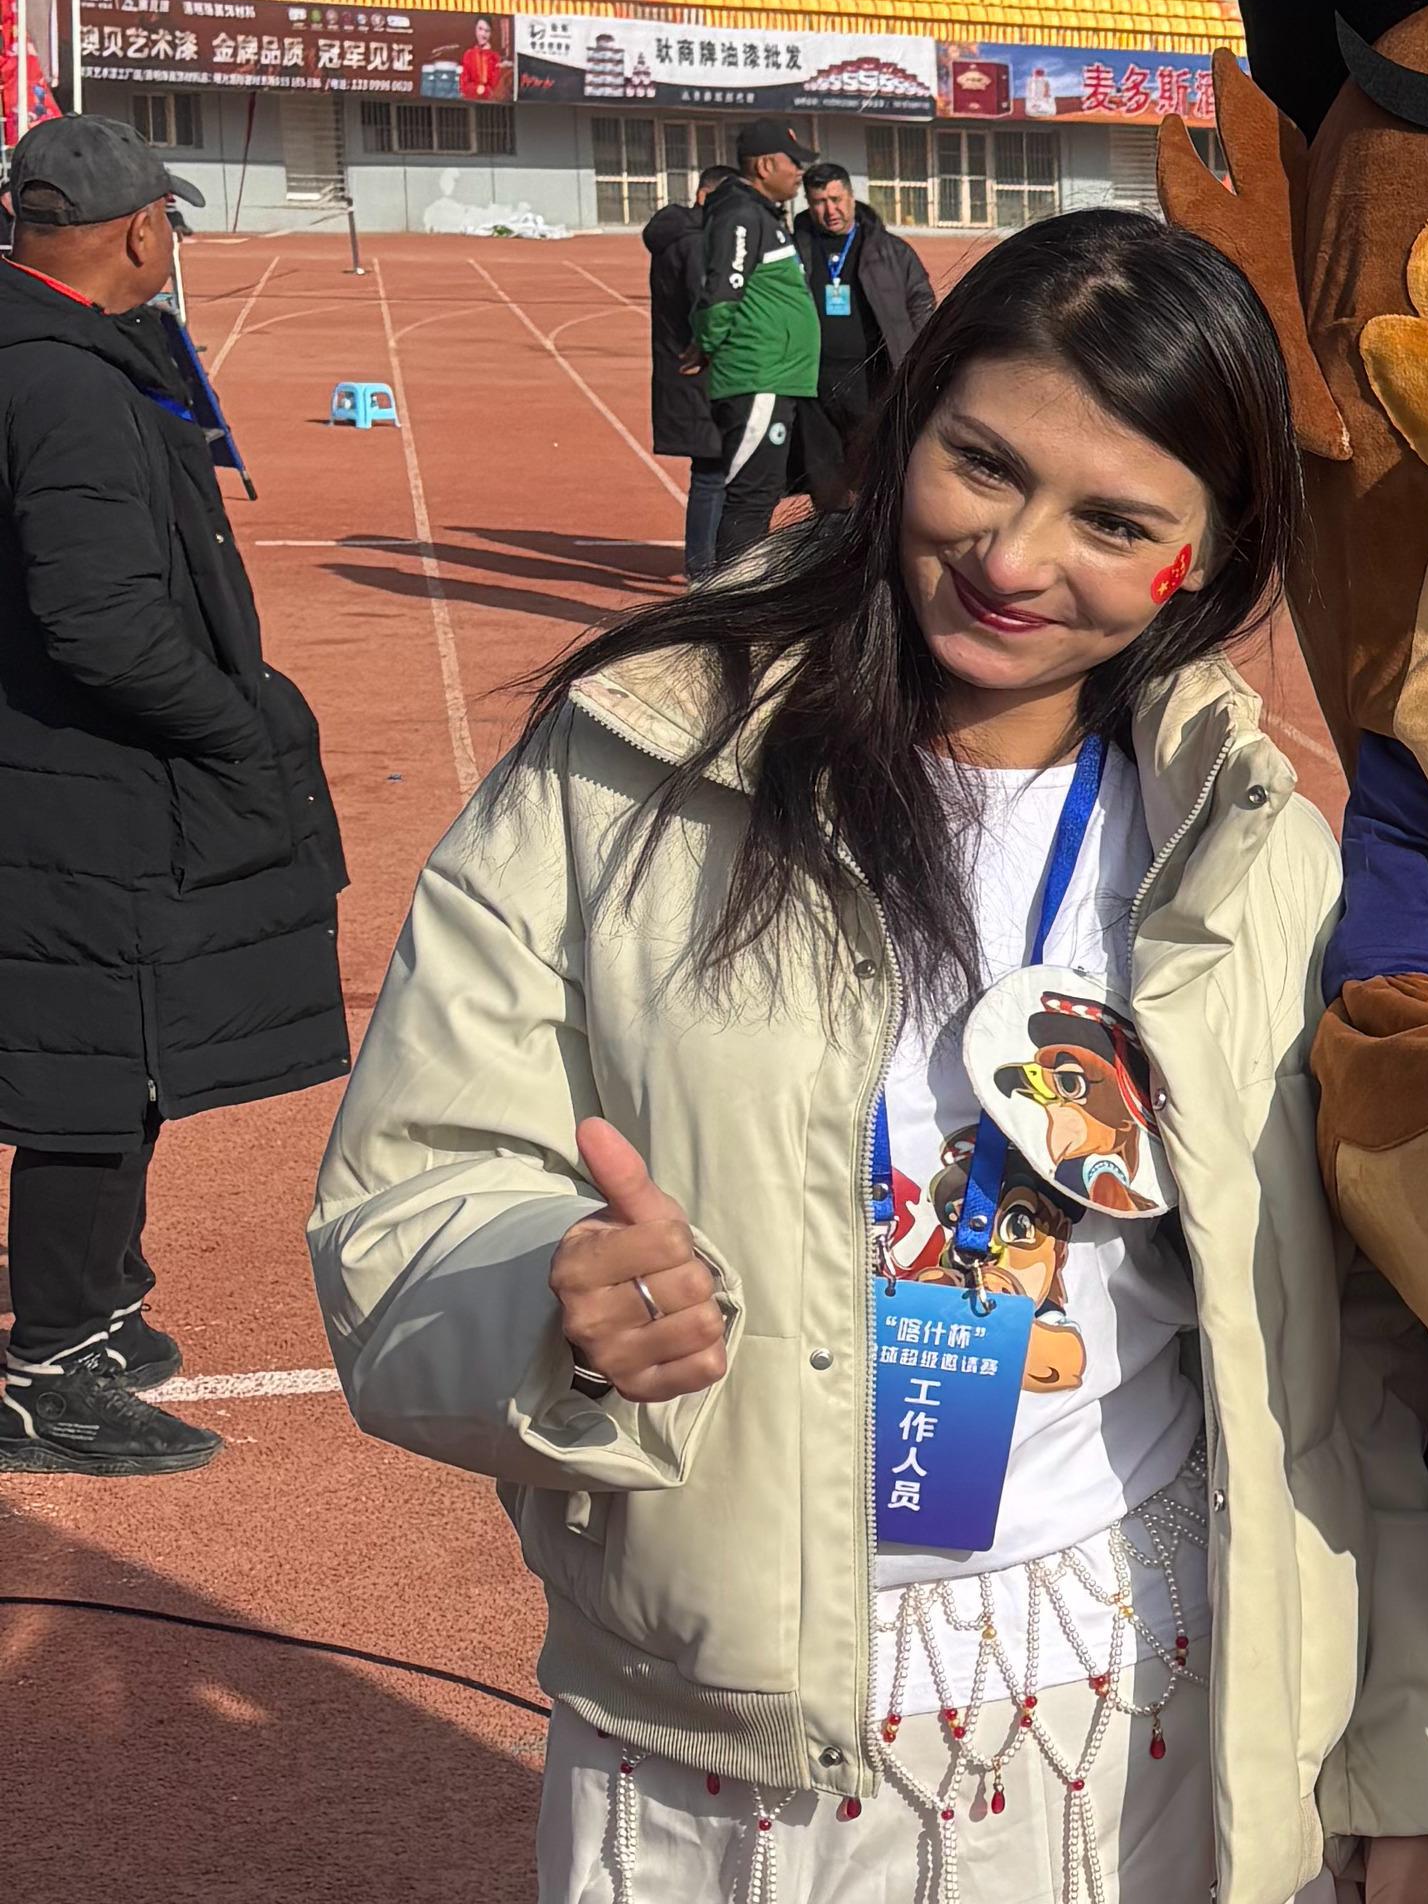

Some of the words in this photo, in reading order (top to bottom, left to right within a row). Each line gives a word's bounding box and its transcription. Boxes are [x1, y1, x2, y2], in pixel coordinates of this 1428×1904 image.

[212, 32, 304, 68] 金牌品质
[318, 38, 414, 72] 冠军见证
[885, 1314, 987, 1350] “喀什杯”
[887, 1377, 942, 1512] 工作人员
